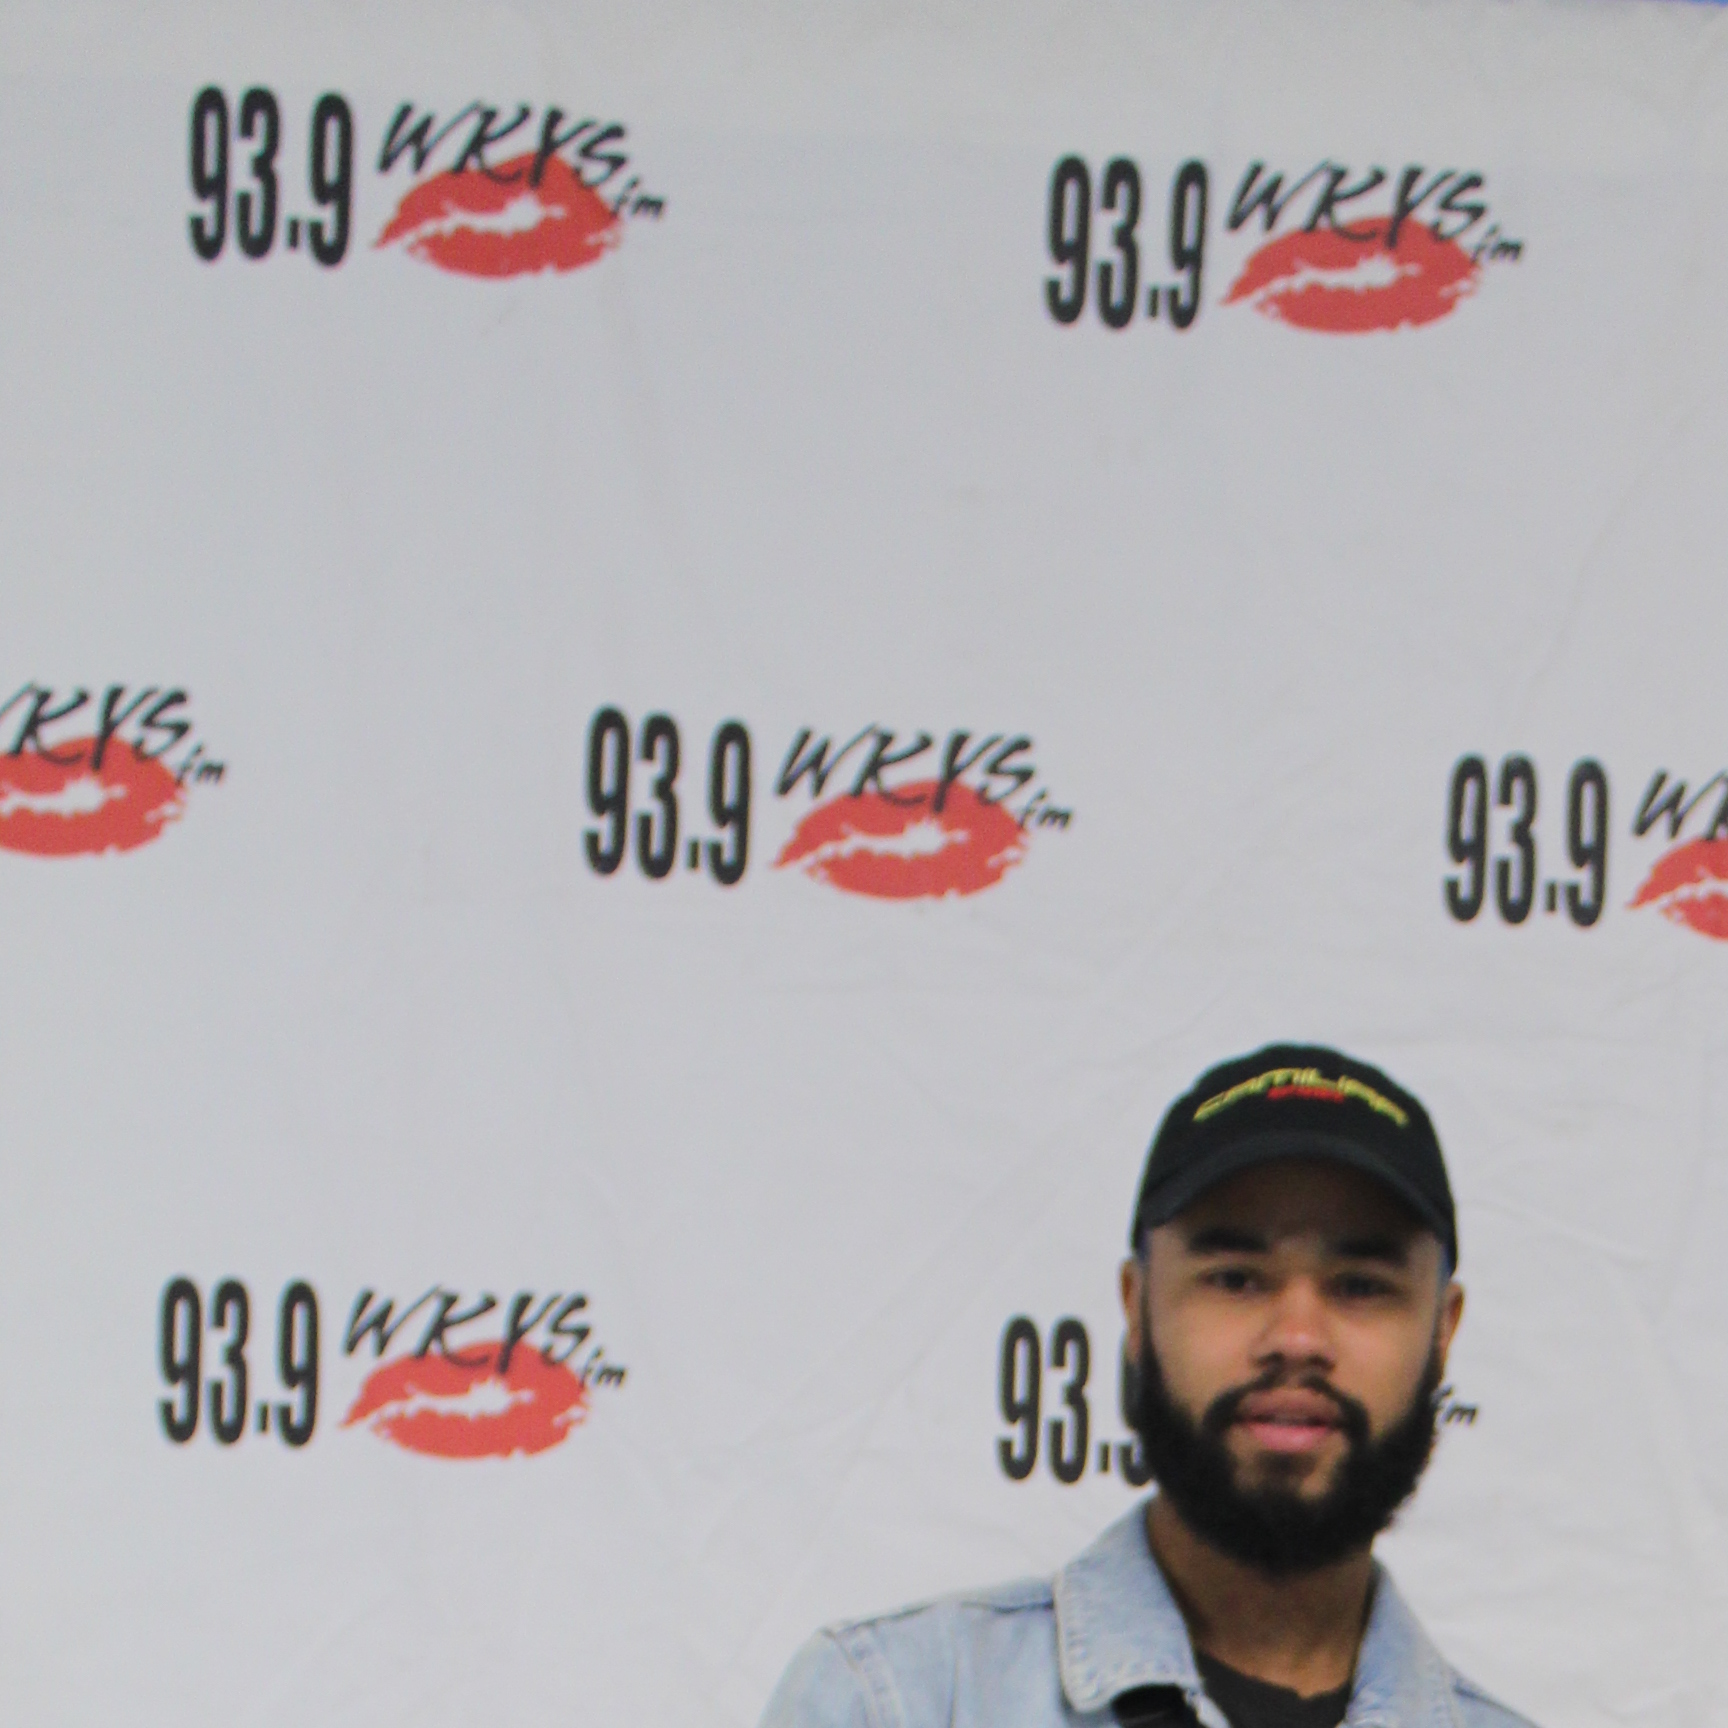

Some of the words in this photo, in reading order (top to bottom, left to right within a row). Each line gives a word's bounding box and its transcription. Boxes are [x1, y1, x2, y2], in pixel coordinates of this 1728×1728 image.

[188, 84, 355, 267] 93.9
[376, 102, 628, 190] WKYS
[1044, 153, 1210, 330] 93.9
[1225, 161, 1487, 250] WKYS
[583, 705, 751, 886] 93.9
[775, 726, 1035, 813] WKYS
[1444, 754, 1609, 927] 93.9
[158, 1276, 319, 1447] 93.9
[343, 1289, 590, 1374] WKYS
